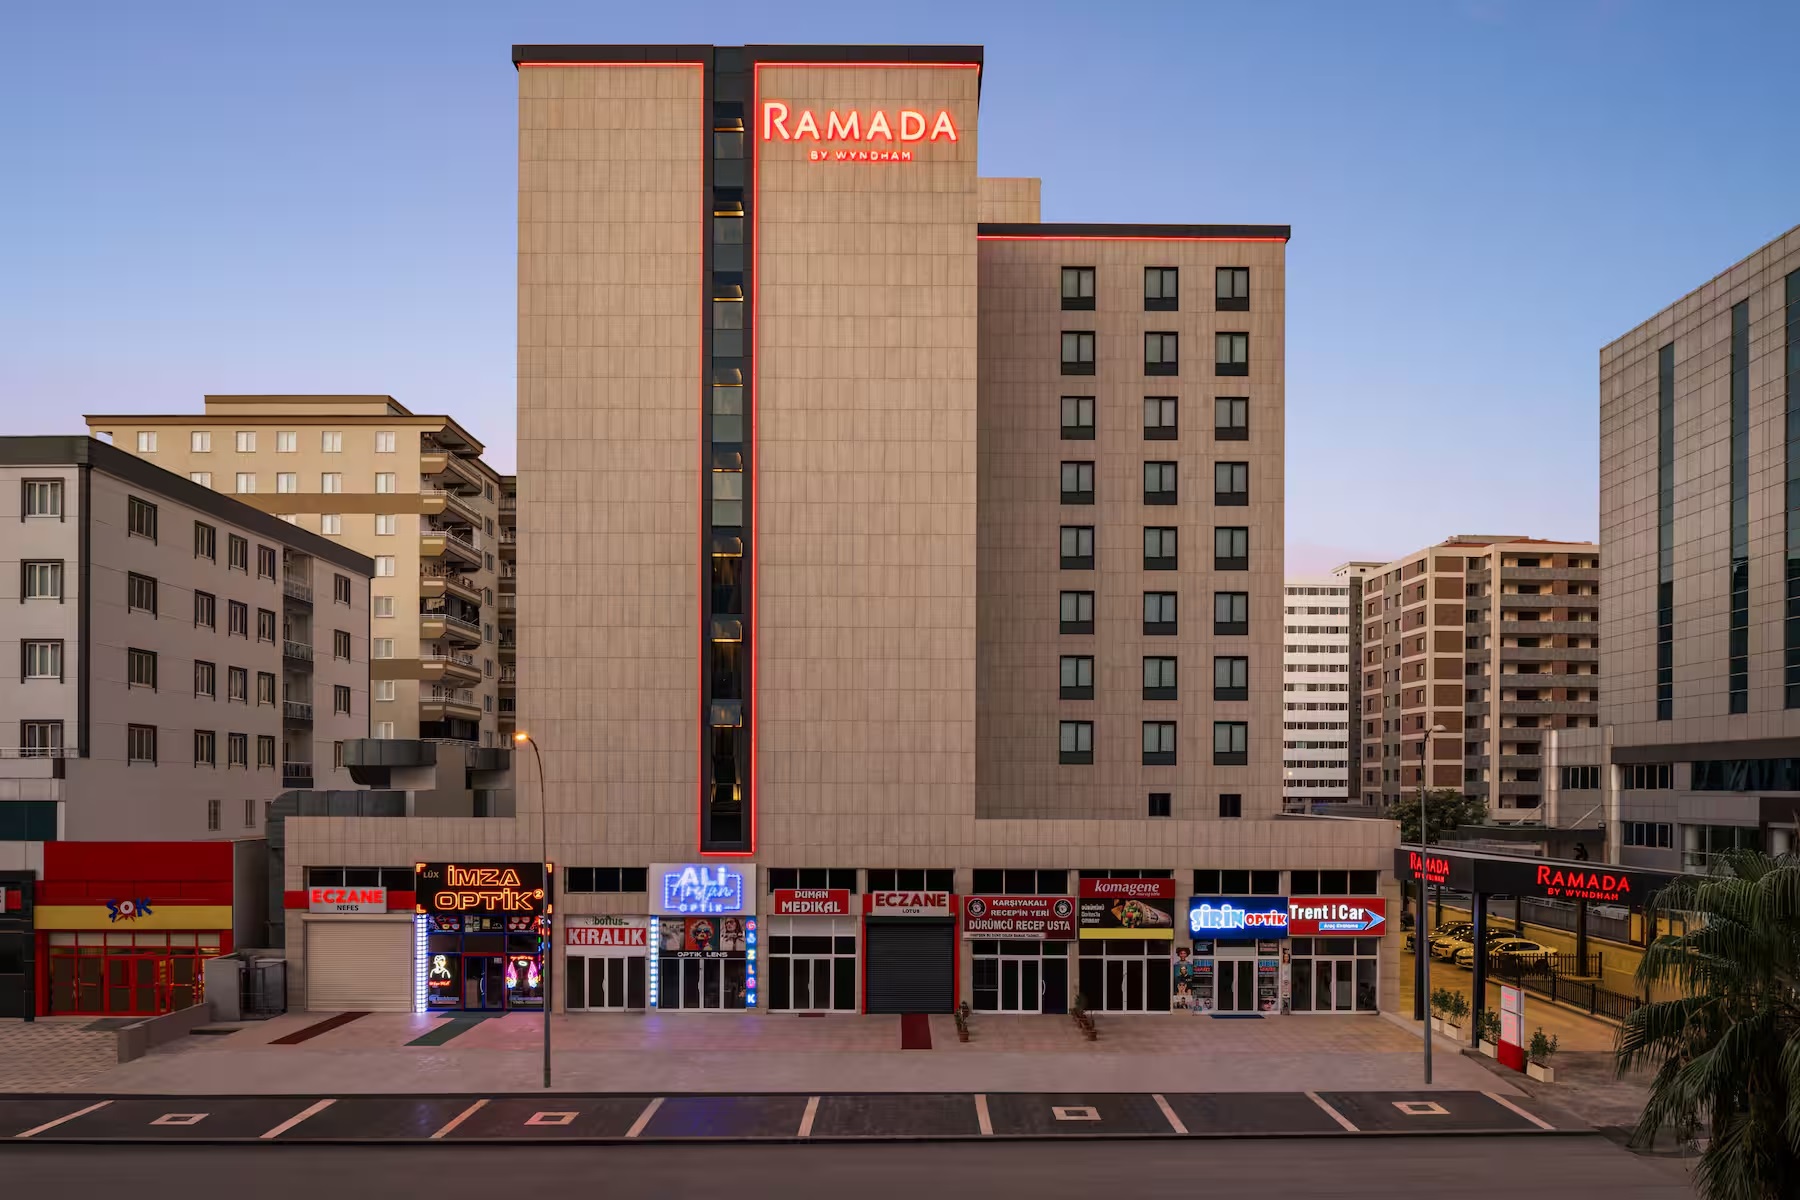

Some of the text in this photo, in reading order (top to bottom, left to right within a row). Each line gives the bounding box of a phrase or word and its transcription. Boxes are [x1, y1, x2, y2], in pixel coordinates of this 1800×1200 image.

[763, 102, 957, 140] RAMADA
[811, 151, 911, 160] BY WYNDHAM
[447, 865, 521, 886] İMZA
[1537, 865, 1630, 892] RAMADA
[794, 890, 829, 899] DUMAN
[1094, 879, 1160, 896] komagene
[1547, 887, 1619, 901] BY WYNDHAM
[311, 889, 384, 904] ECZANE
[435, 887, 533, 910] OPTİK
[875, 893, 947, 907] ECZANE
[1289, 905, 1329, 920] Trent
[1339, 905, 1365, 920] Car
[968, 918, 1014, 930] DÜRÜMCÜ
[1015, 920, 1045, 931] RECEP
[1047, 920, 1071, 931] USTA
